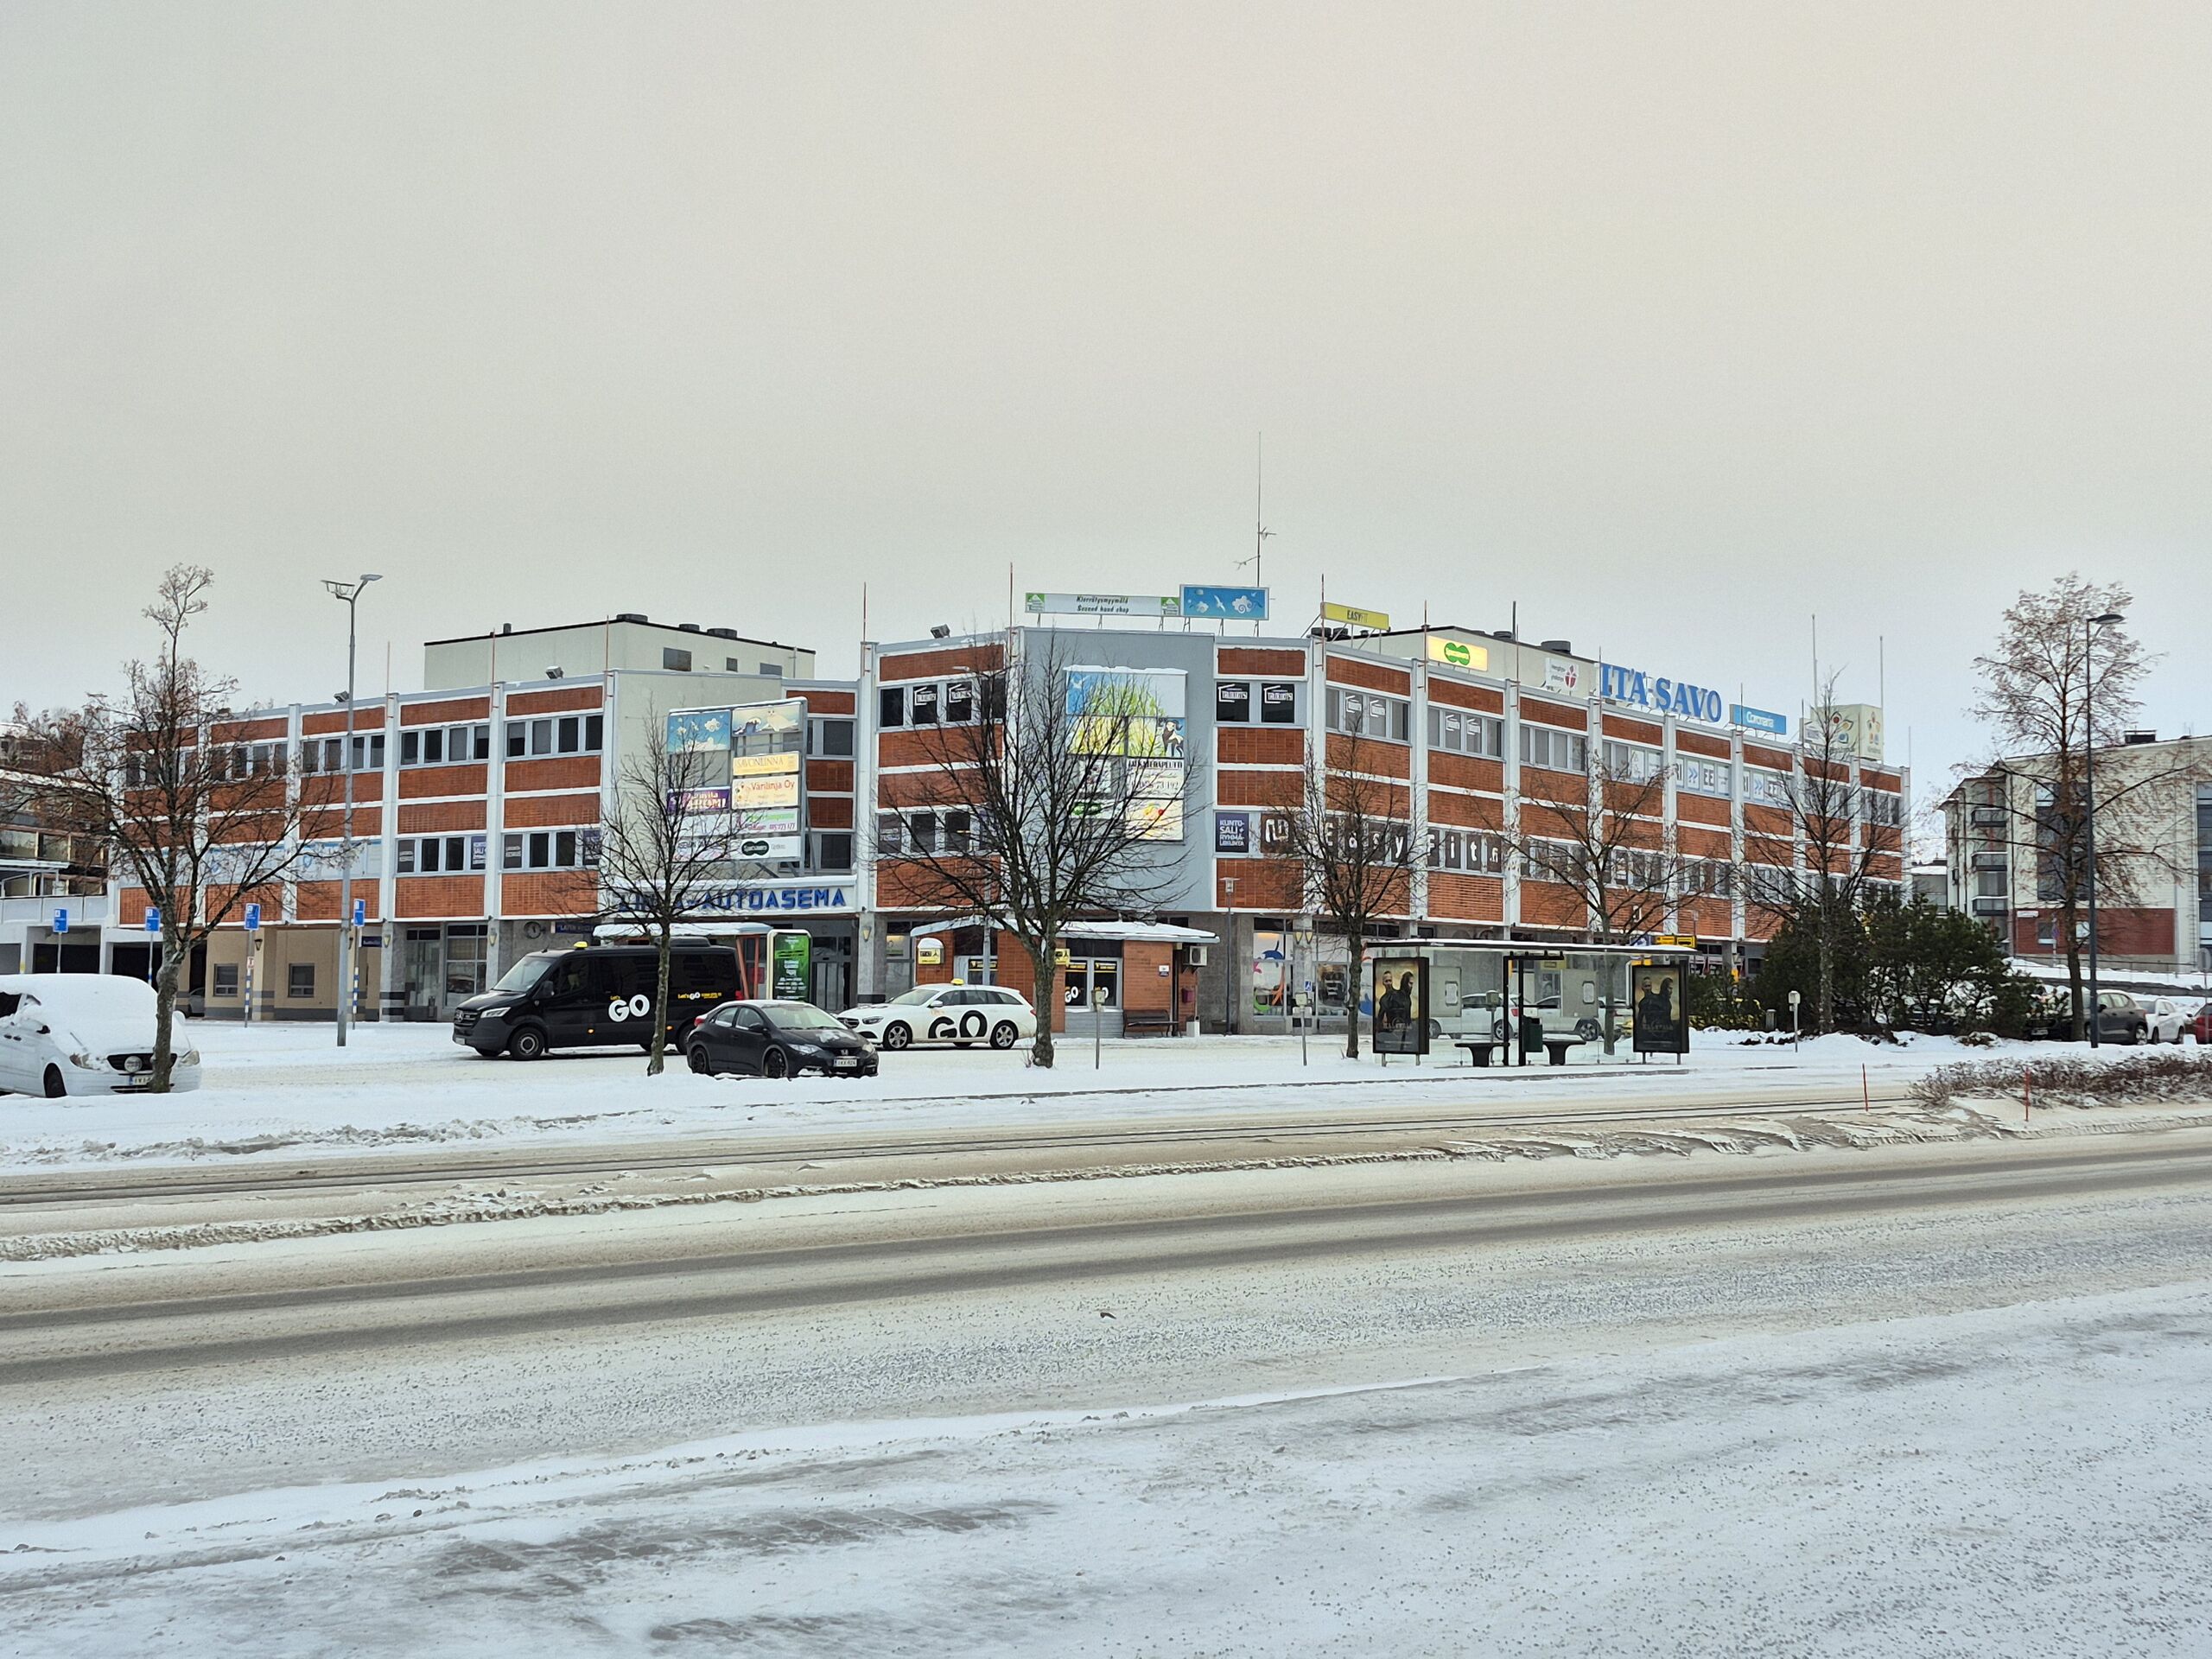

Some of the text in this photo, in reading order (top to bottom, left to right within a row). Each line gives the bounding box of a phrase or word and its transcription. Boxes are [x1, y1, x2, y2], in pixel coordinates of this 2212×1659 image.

[1116, 606, 1129, 614] shop
[608, 994, 650, 1022] GO
[928, 1010, 988, 1039] GO
